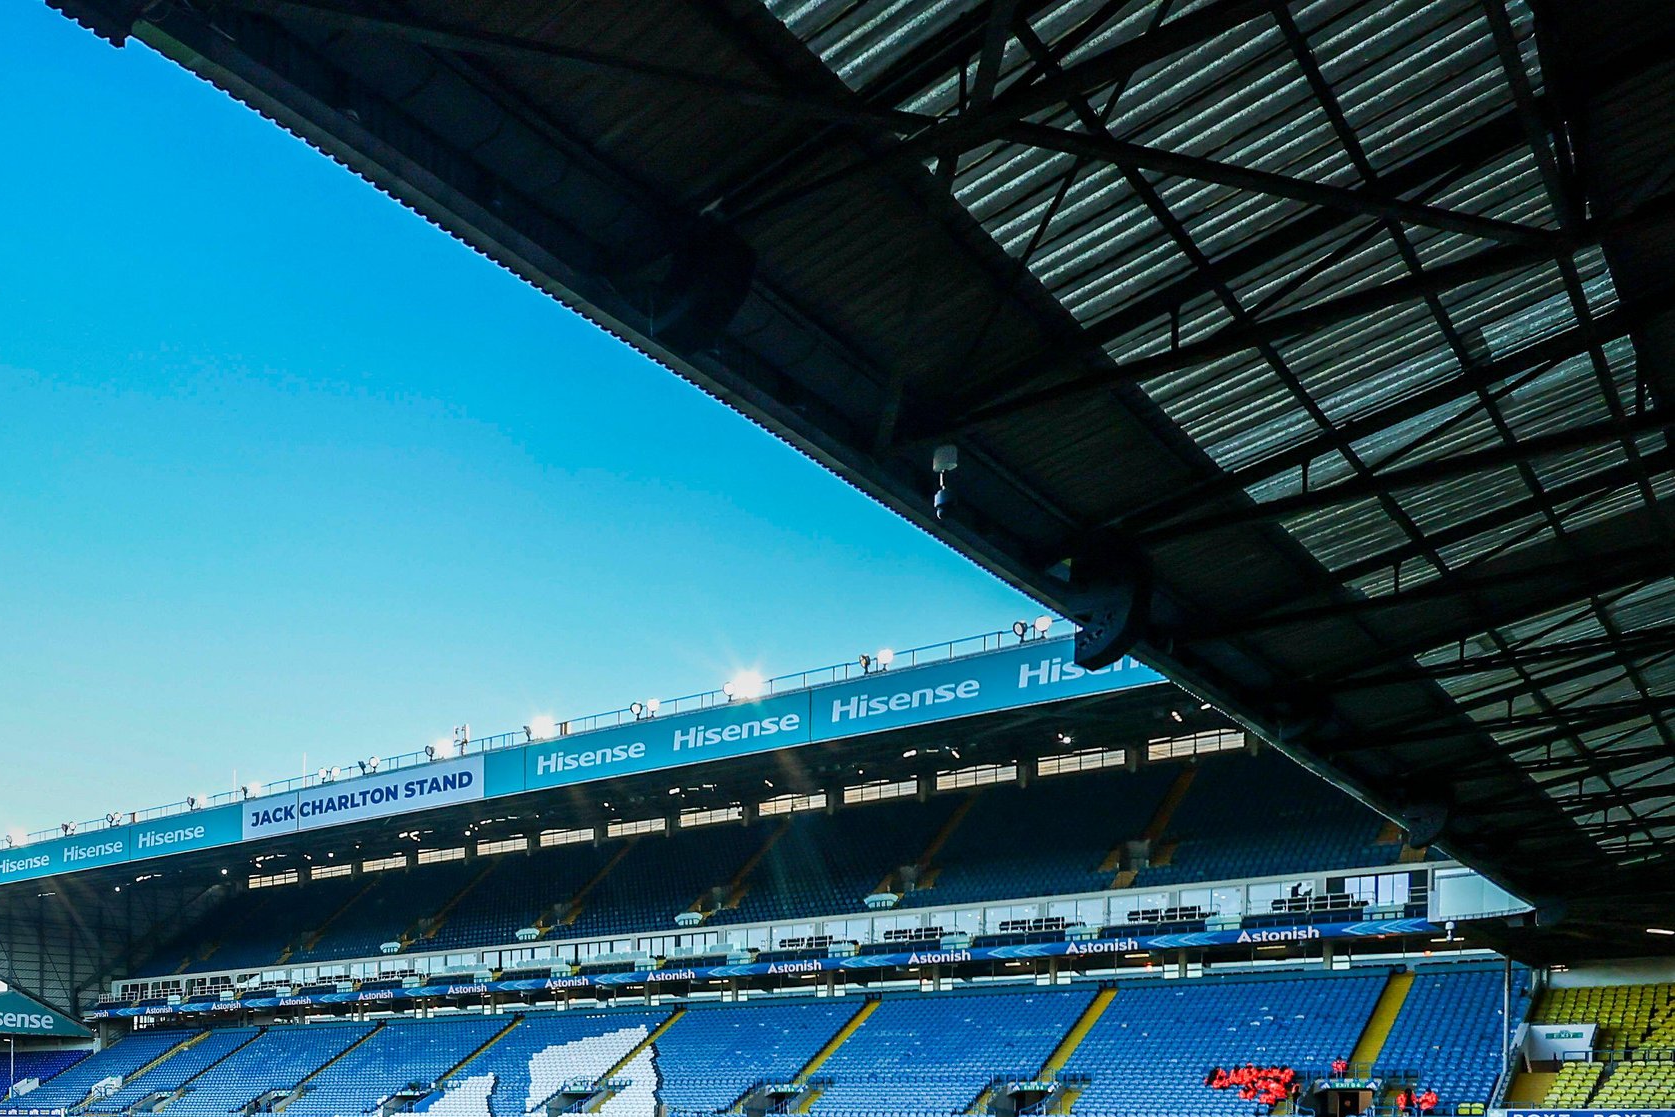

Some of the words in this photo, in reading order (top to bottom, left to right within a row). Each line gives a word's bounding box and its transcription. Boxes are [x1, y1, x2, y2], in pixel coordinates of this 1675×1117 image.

[832, 679, 980, 723] Hisense
[673, 712, 800, 751] Hisense
[536, 739, 646, 775] Hisense
[250, 803, 296, 828] JACK
[299, 784, 399, 818] CHARLTON
[404, 770, 473, 796] STAND
[137, 824, 205, 849] Hisense
[63, 838, 123, 863] Hisense
[1236, 925, 1320, 944] Astonish
[1065, 938, 1138, 955] Astonish
[907, 949, 971, 965] Astonish
[767, 958, 822, 974] Astonish
[544, 976, 589, 989] Astonish
[646, 969, 695, 982] Astonish
[358, 989, 393, 1001] Astonish
[447, 983, 487, 995] Astonish
[211, 1001, 241, 1011] Astonish
[279, 996, 311, 1007] Astonish
[145, 1005, 173, 1016] Astonish
